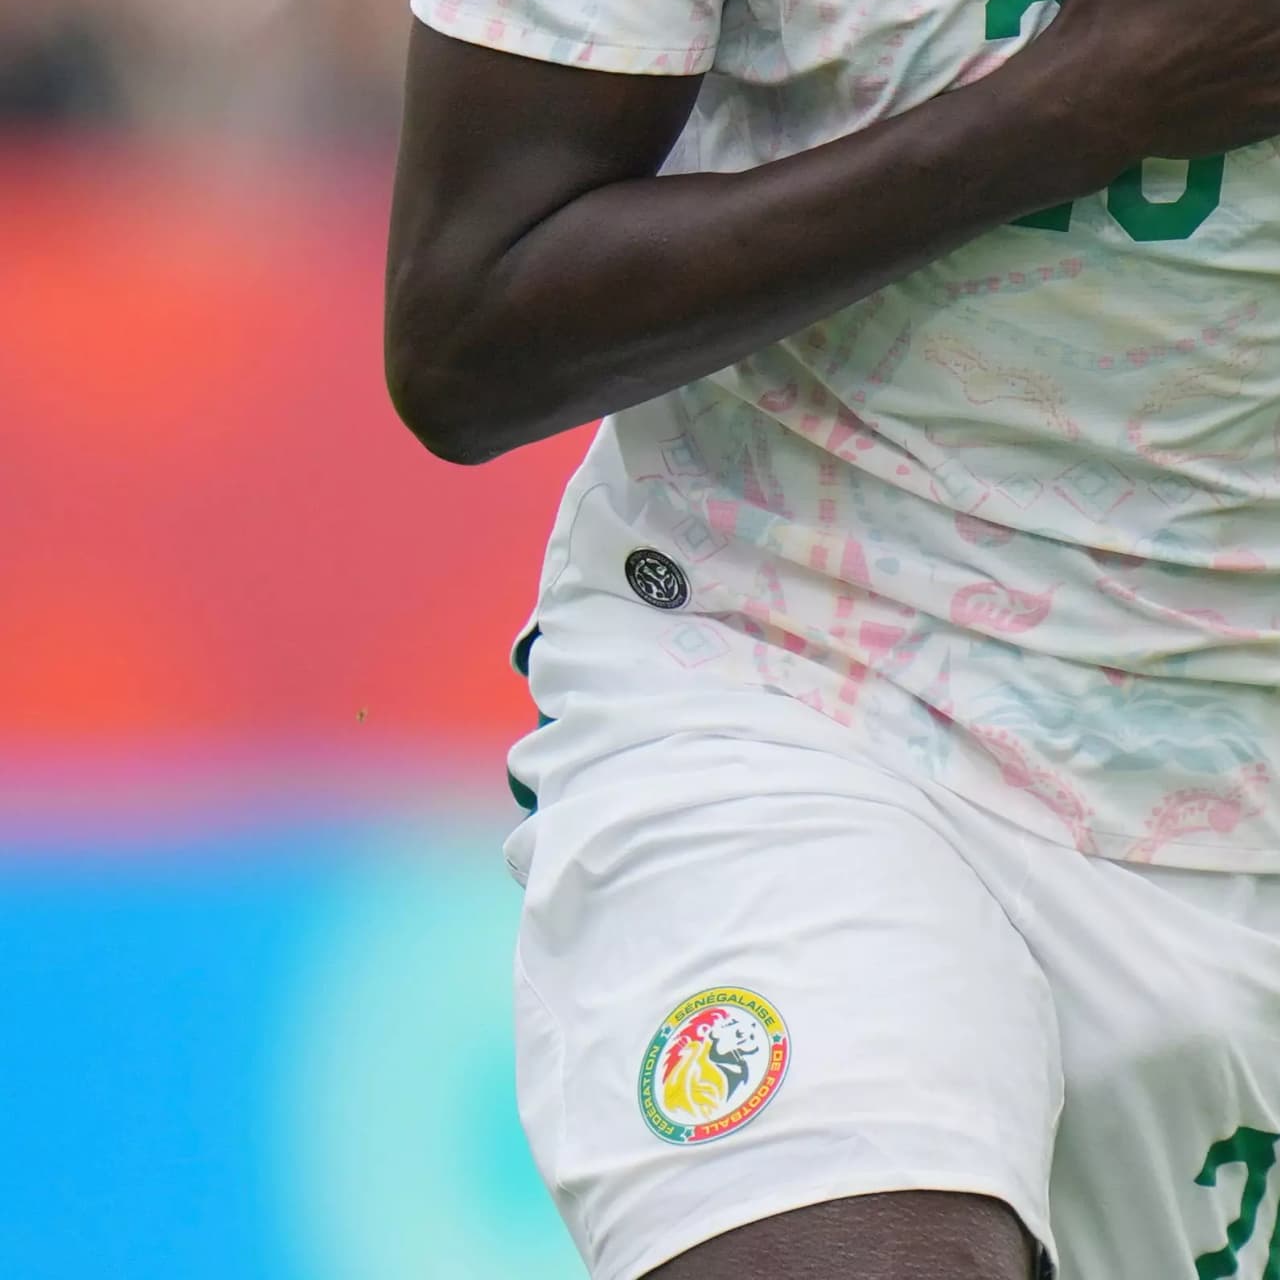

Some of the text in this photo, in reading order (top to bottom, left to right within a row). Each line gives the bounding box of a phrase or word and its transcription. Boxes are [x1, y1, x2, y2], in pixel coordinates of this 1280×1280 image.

[675, 992, 775, 1027] SÉNÉGALAISE
[771, 1050, 783, 1071] DE
[702, 1076, 775, 1134] FOOTBALL
